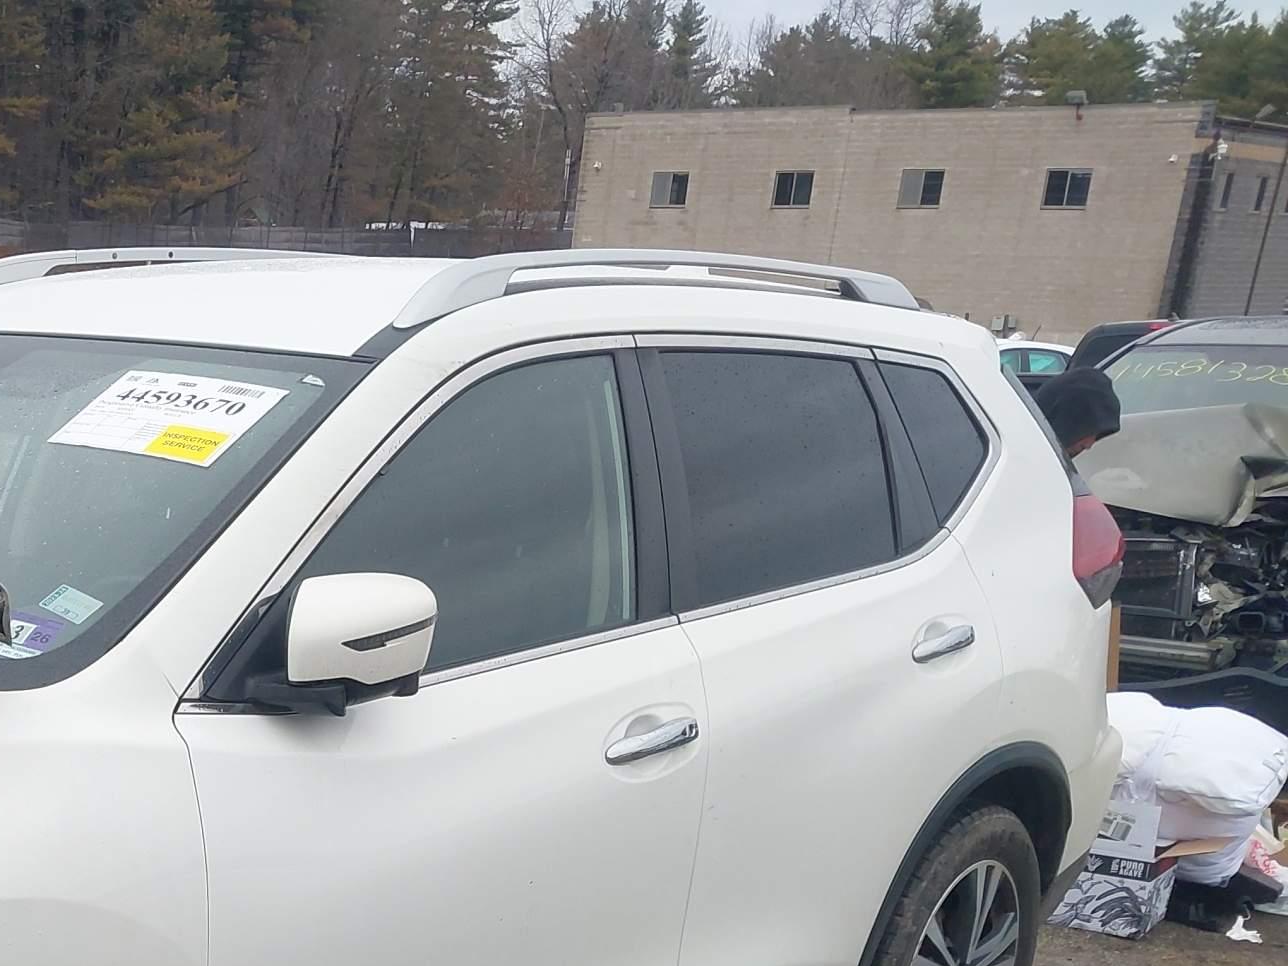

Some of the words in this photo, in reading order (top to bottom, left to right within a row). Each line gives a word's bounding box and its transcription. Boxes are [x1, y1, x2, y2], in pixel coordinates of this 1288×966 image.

[116, 387, 246, 417] 44593670
[161, 439, 207, 454] SERVICE
[162, 431, 221, 448] INSPECTION
[30, 631, 52, 644] 26
[1118, 868, 1143, 878] AGAVE
